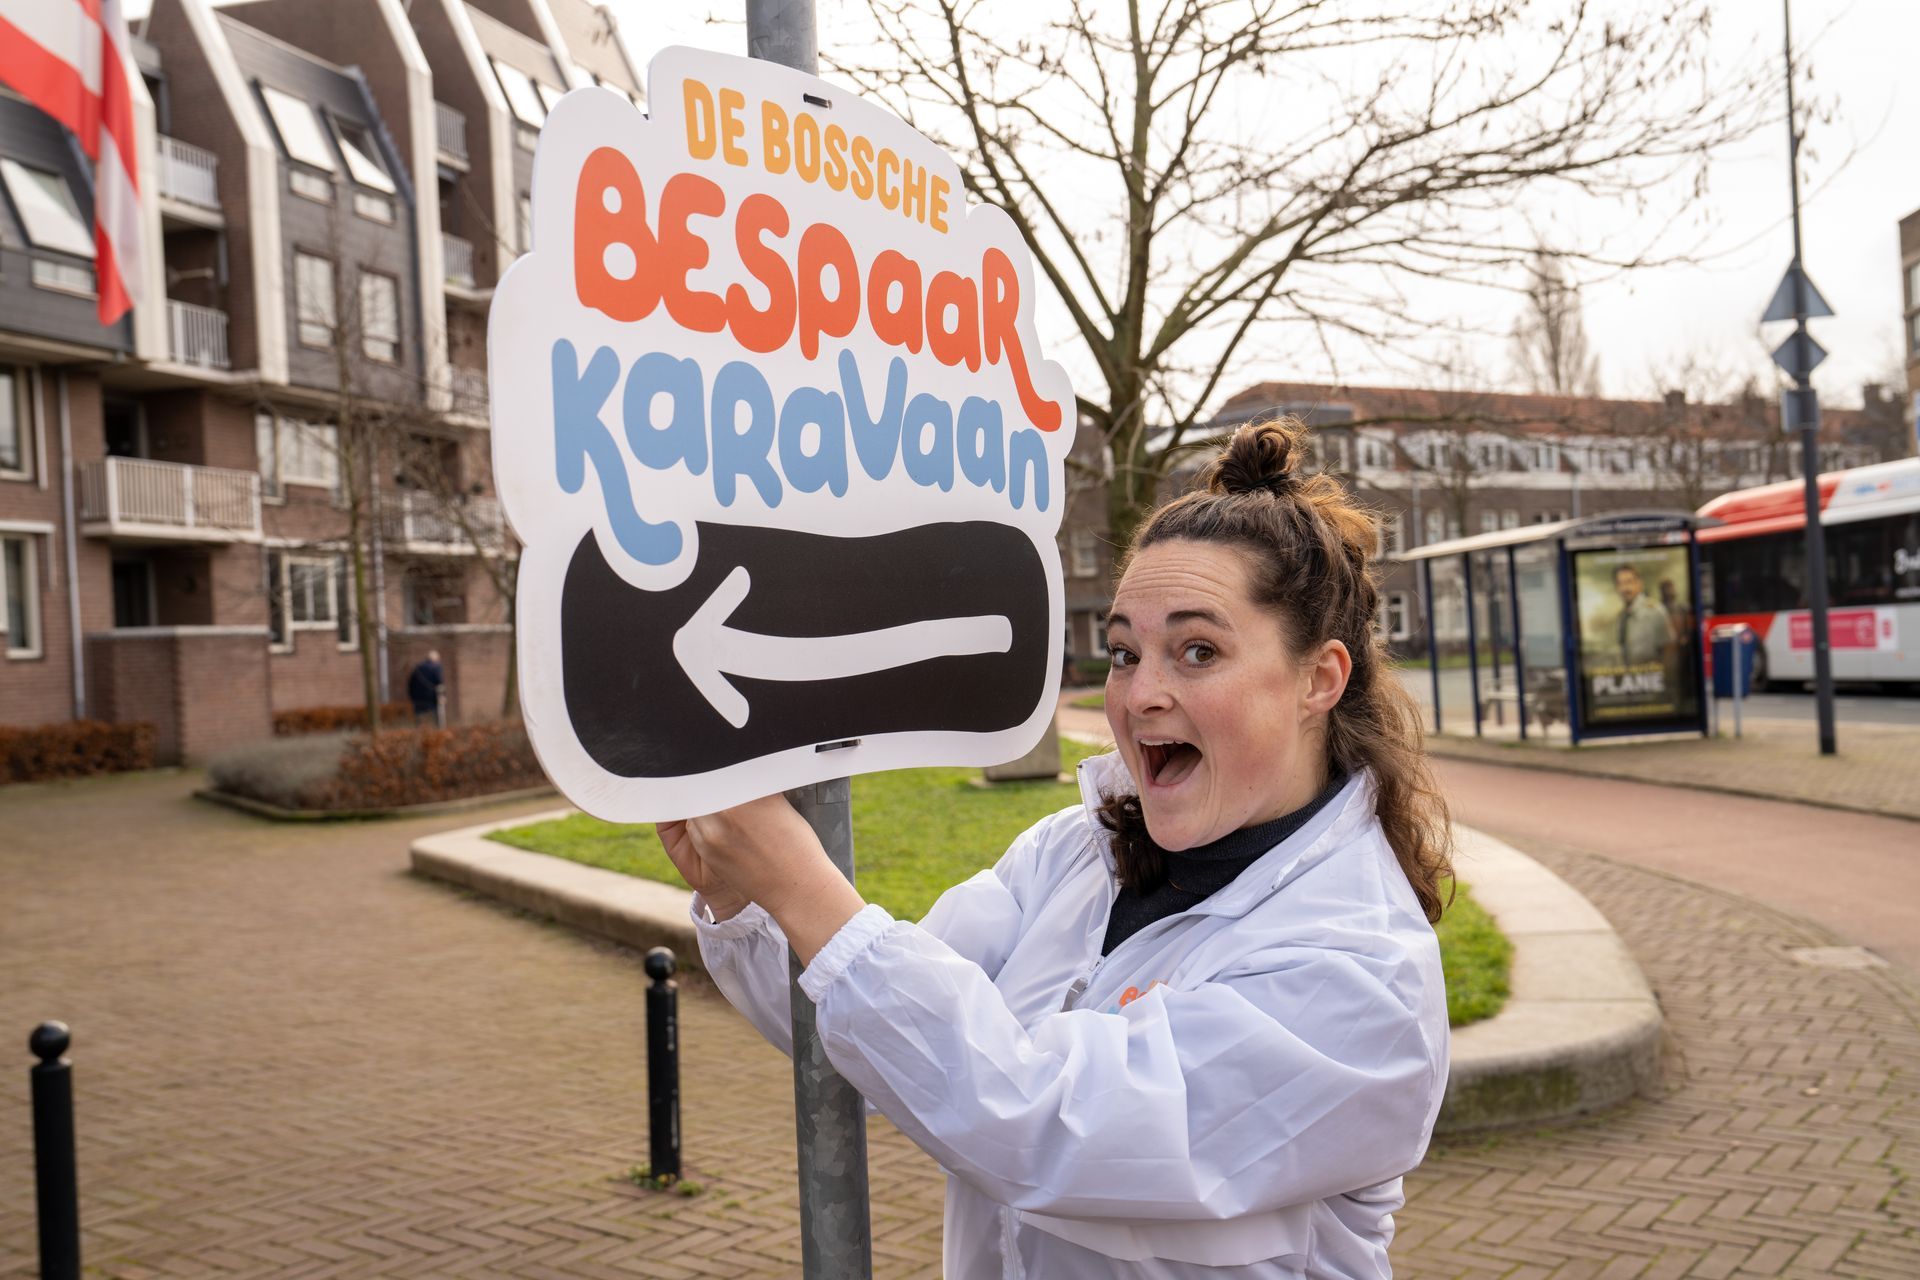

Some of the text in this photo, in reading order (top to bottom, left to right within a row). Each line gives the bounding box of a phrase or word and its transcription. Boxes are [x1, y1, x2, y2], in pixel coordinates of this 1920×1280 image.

[682, 78, 951, 235] DE BOSSCHE
[1592, 673, 1665, 696] PLANE
